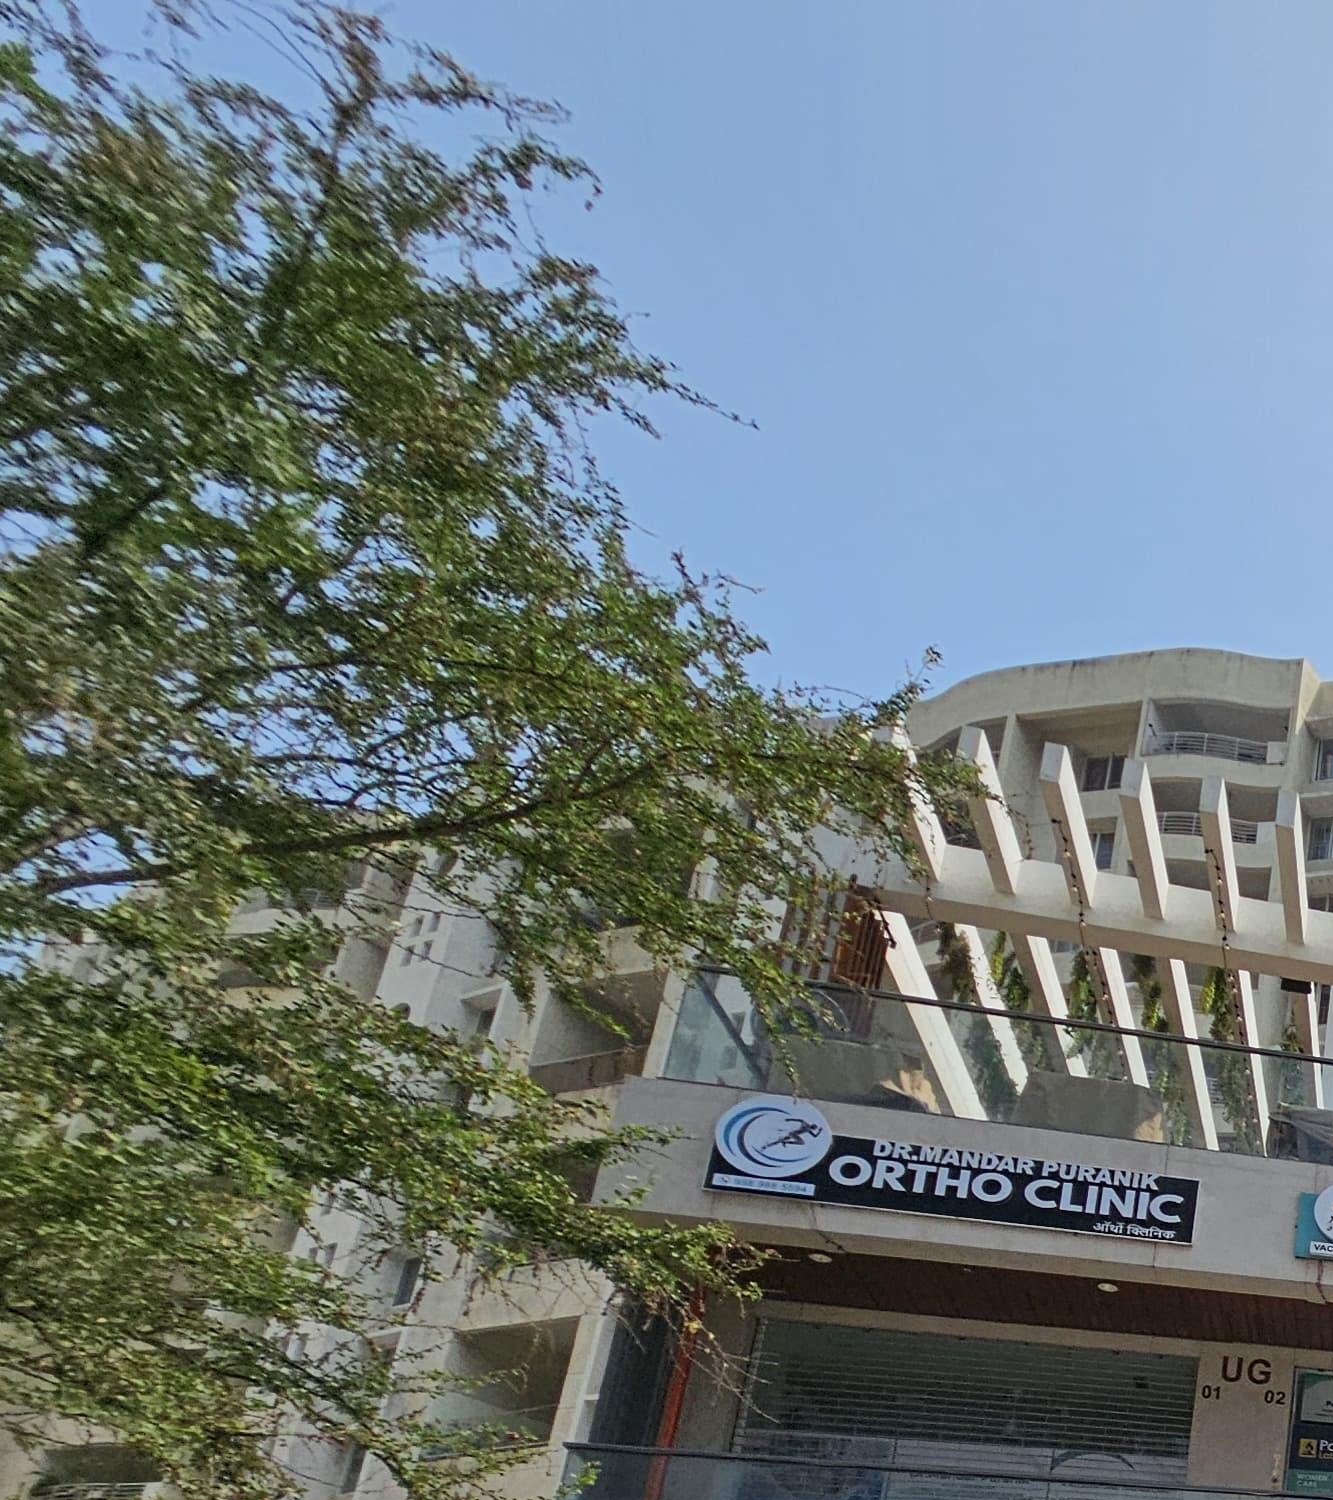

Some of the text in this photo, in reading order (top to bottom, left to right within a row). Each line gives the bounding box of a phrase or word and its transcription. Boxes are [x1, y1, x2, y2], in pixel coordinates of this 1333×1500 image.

[873, 1140, 1160, 1191] DR.MANDAR PURANIK
[829, 1155, 1013, 1203] ORTHO
[1024, 1179, 1185, 1223] CLINIC
[1222, 1355, 1272, 1385] UG
[1201, 1385, 1286, 1405] 01 02
